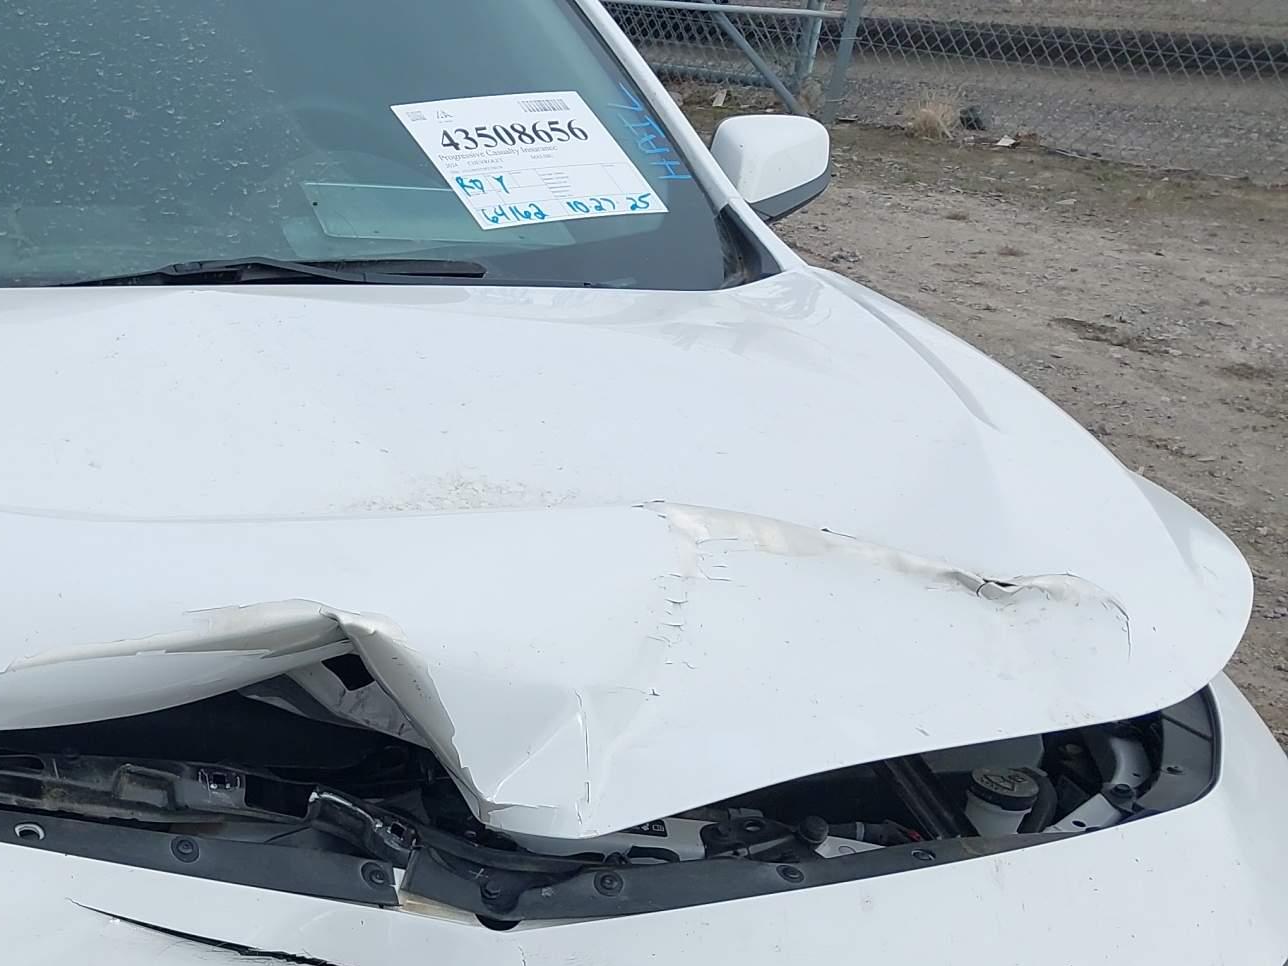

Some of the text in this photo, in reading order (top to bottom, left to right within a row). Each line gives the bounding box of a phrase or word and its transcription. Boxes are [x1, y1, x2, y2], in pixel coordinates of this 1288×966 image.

[441, 119, 589, 151] 43508656
[438, 150, 485, 162] Progressive
[485, 147, 520, 157] Casualty
[520, 144, 558, 154] Insurance
